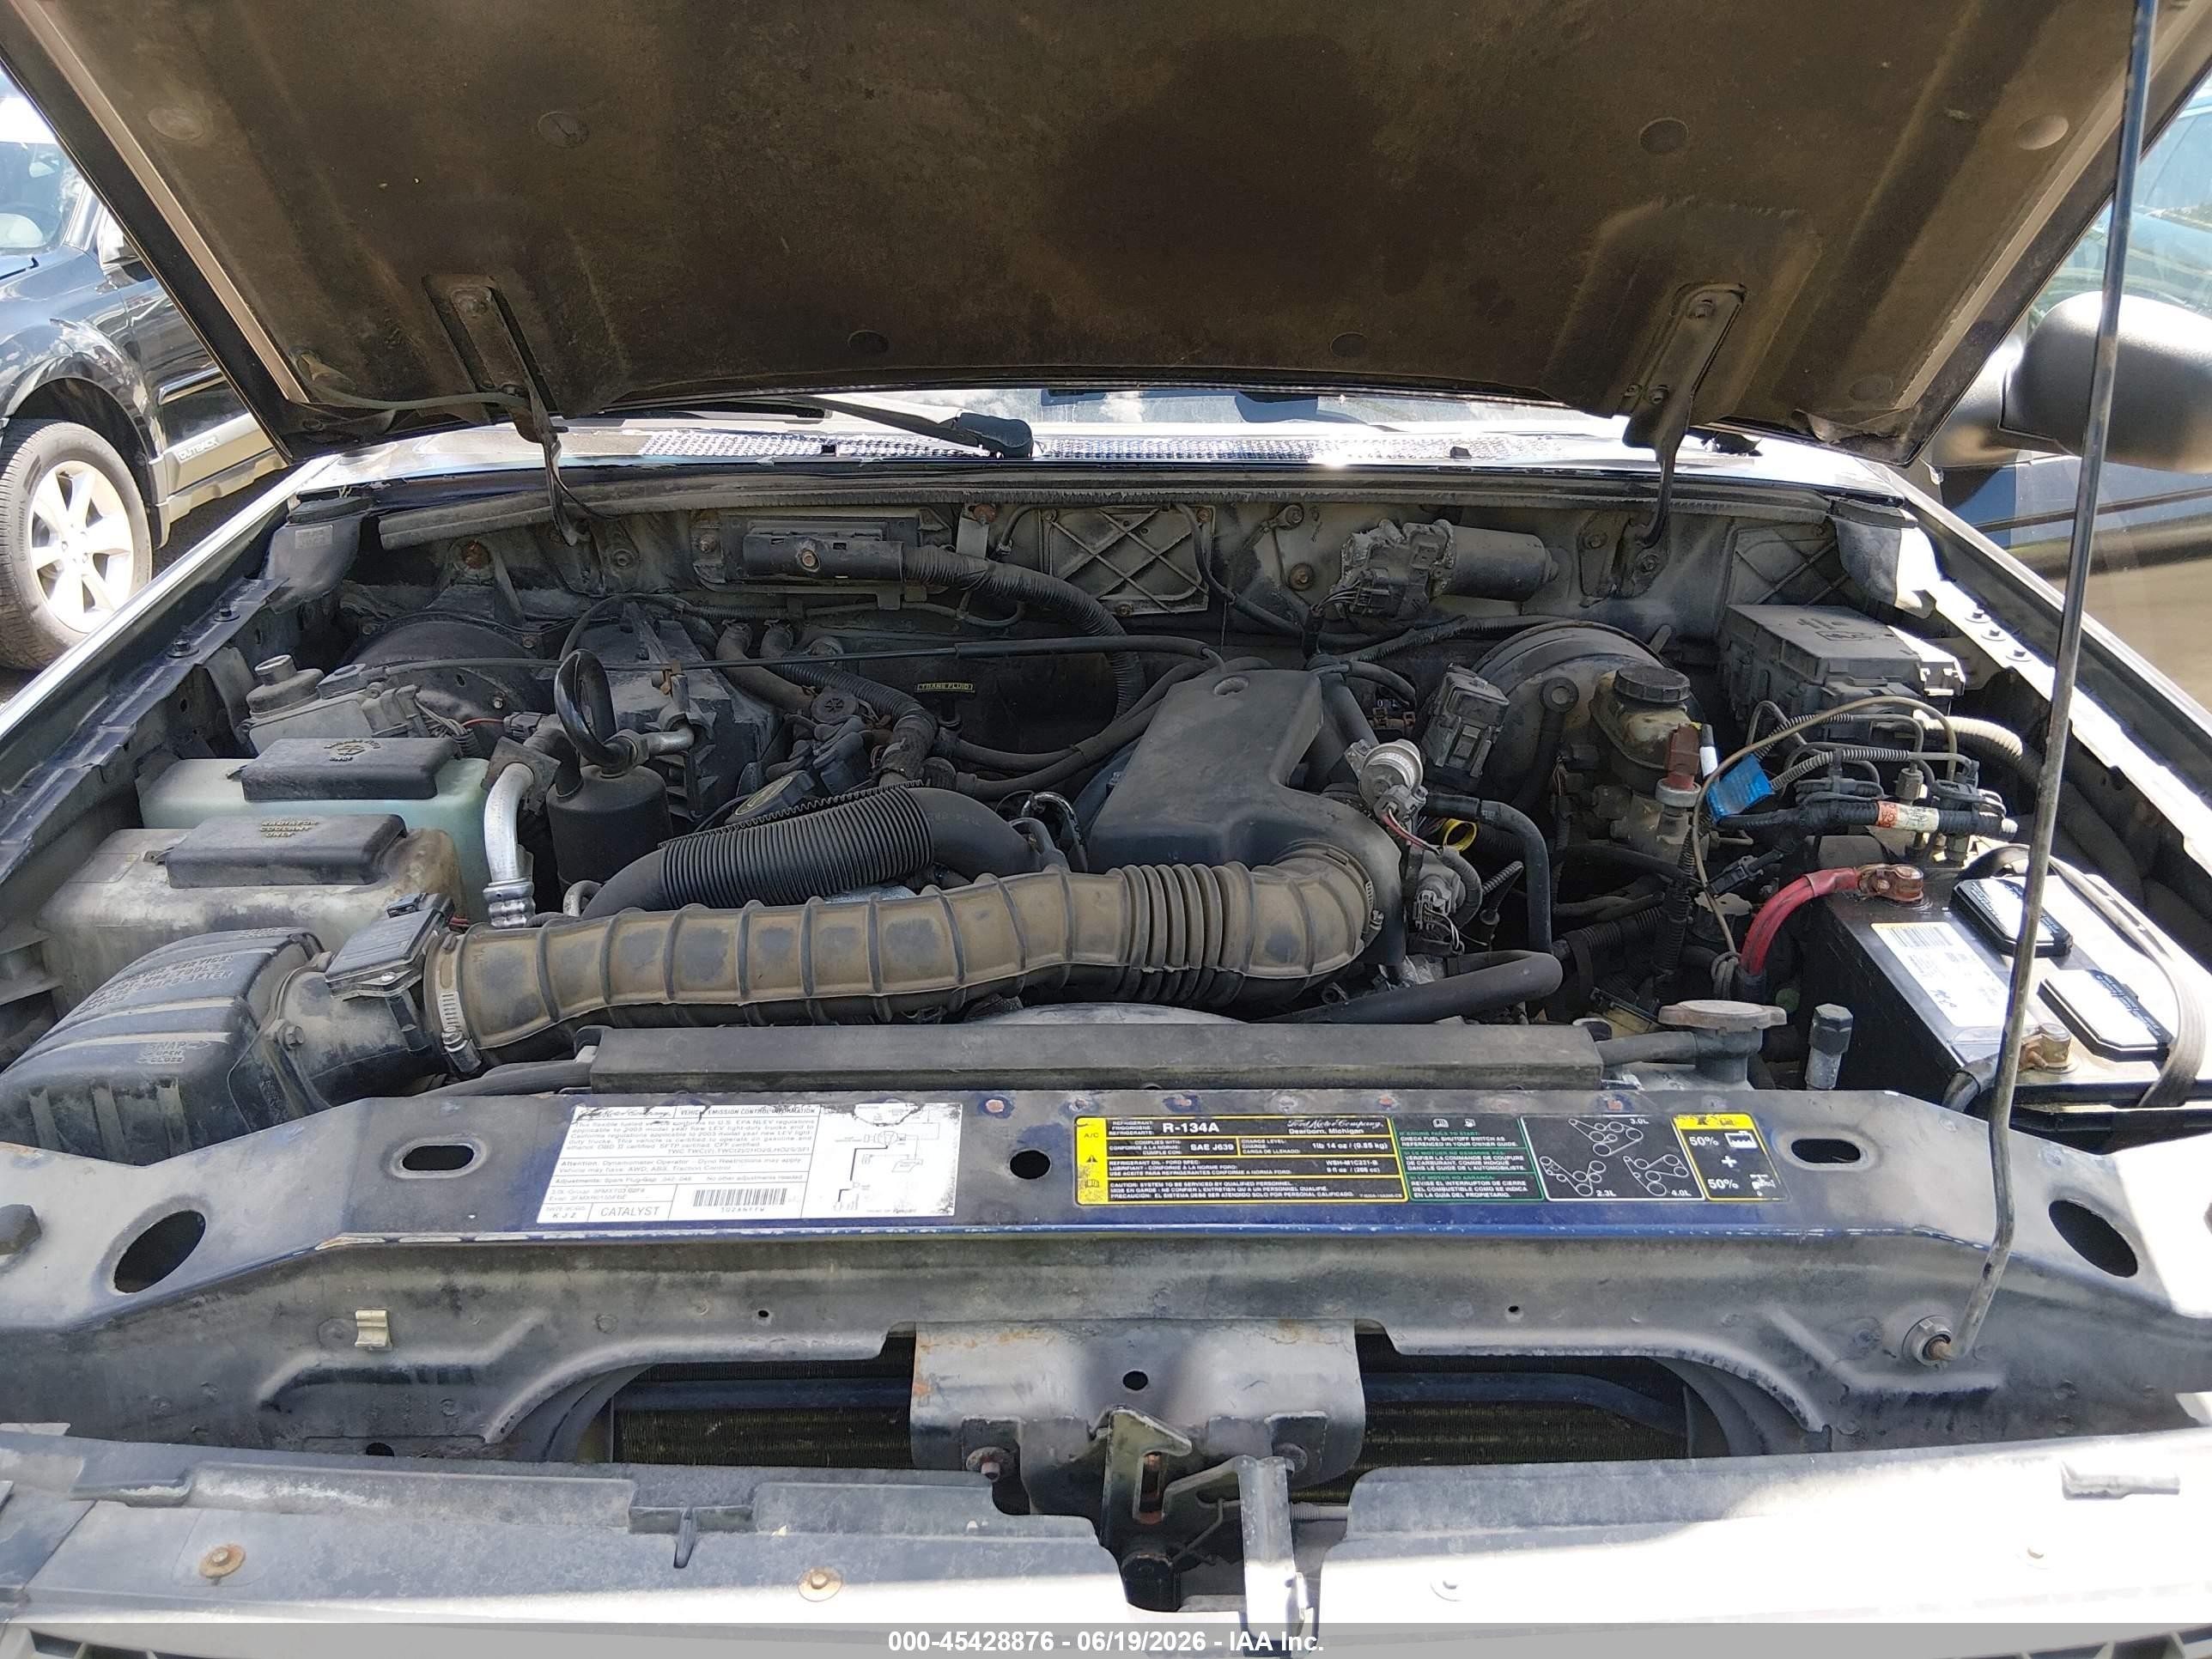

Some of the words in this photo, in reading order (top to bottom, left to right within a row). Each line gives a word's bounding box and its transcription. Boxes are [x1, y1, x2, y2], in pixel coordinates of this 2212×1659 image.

[178, 435, 220, 460] OUTBACK
[149, 1041, 186, 1050] SNAP
[1163, 1122, 1220, 1133] R-134A
[1688, 1136, 1720, 1146] 50%
[1707, 1179, 1740, 1190] 50%
[601, 1206, 660, 1217] CATALYST
